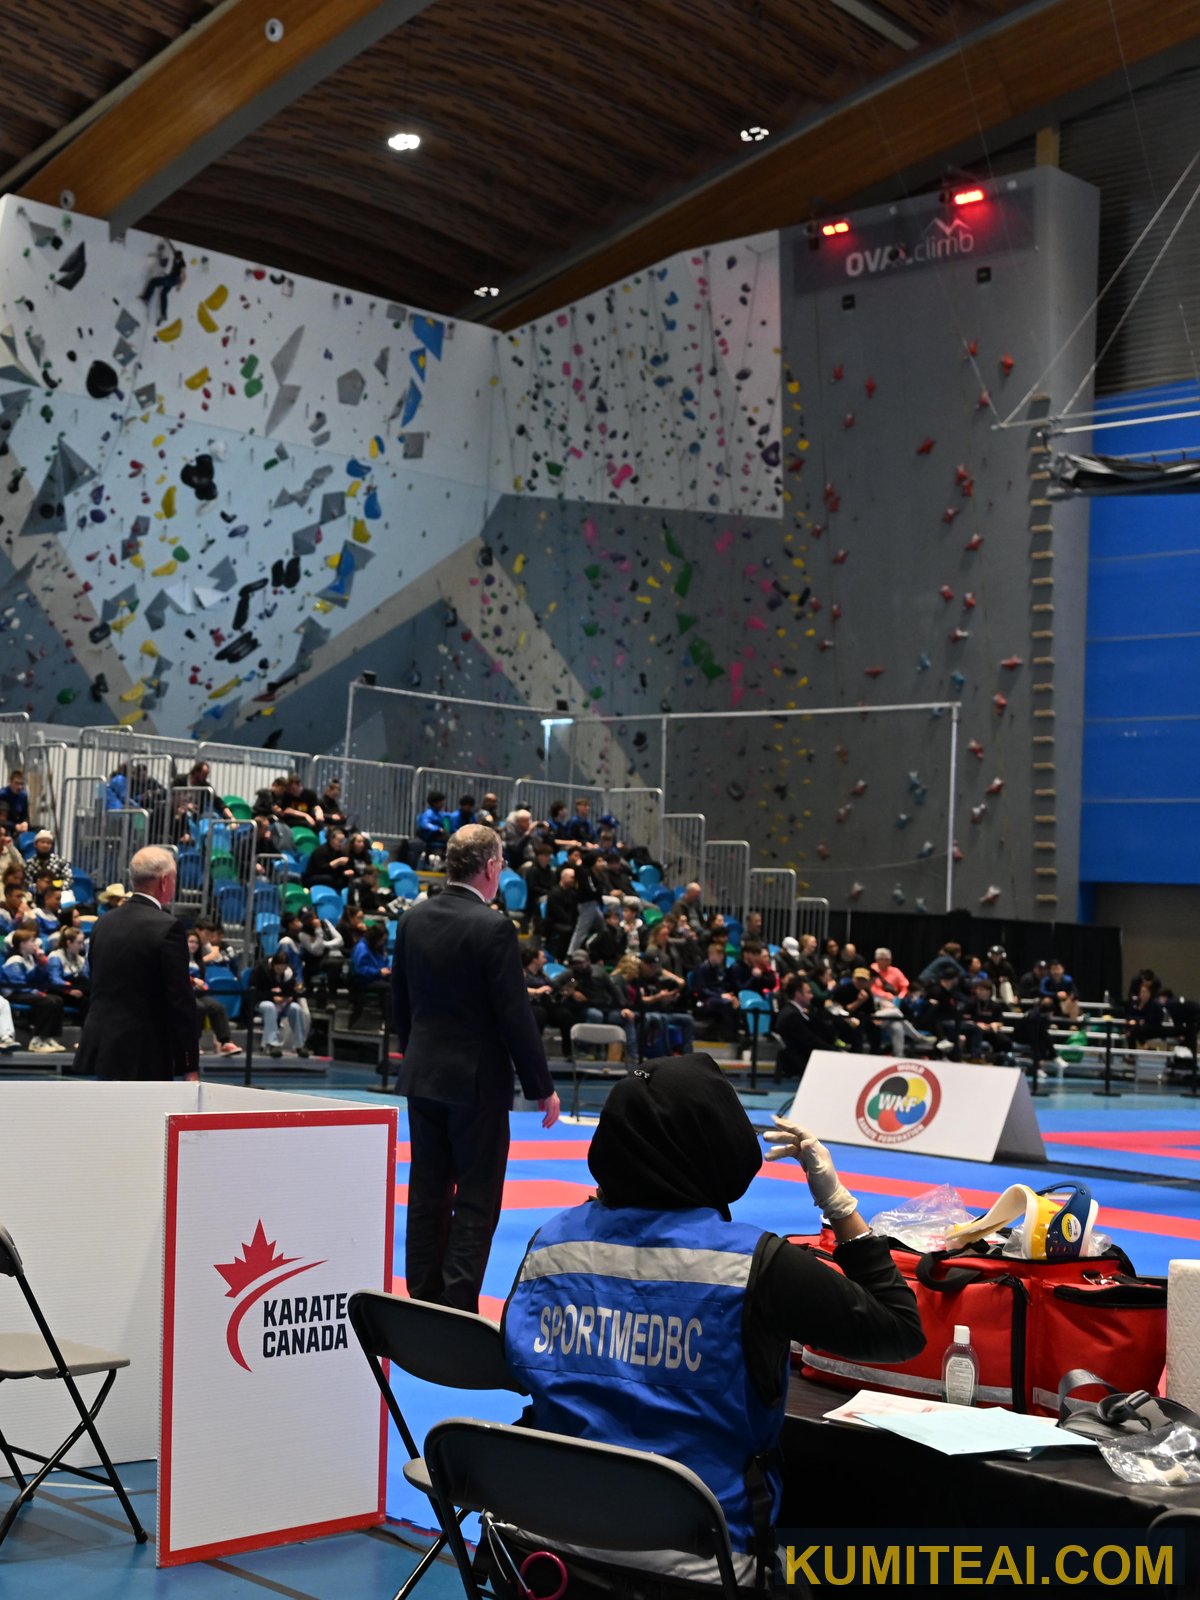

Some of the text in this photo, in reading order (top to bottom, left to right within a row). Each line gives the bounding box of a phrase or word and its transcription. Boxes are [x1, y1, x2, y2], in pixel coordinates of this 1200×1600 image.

[878, 1093, 919, 1113] WKF
[263, 1293, 348, 1328] KARATE
[262, 1323, 348, 1358] CANADA
[533, 1304, 703, 1372] SPORTMEDBC
